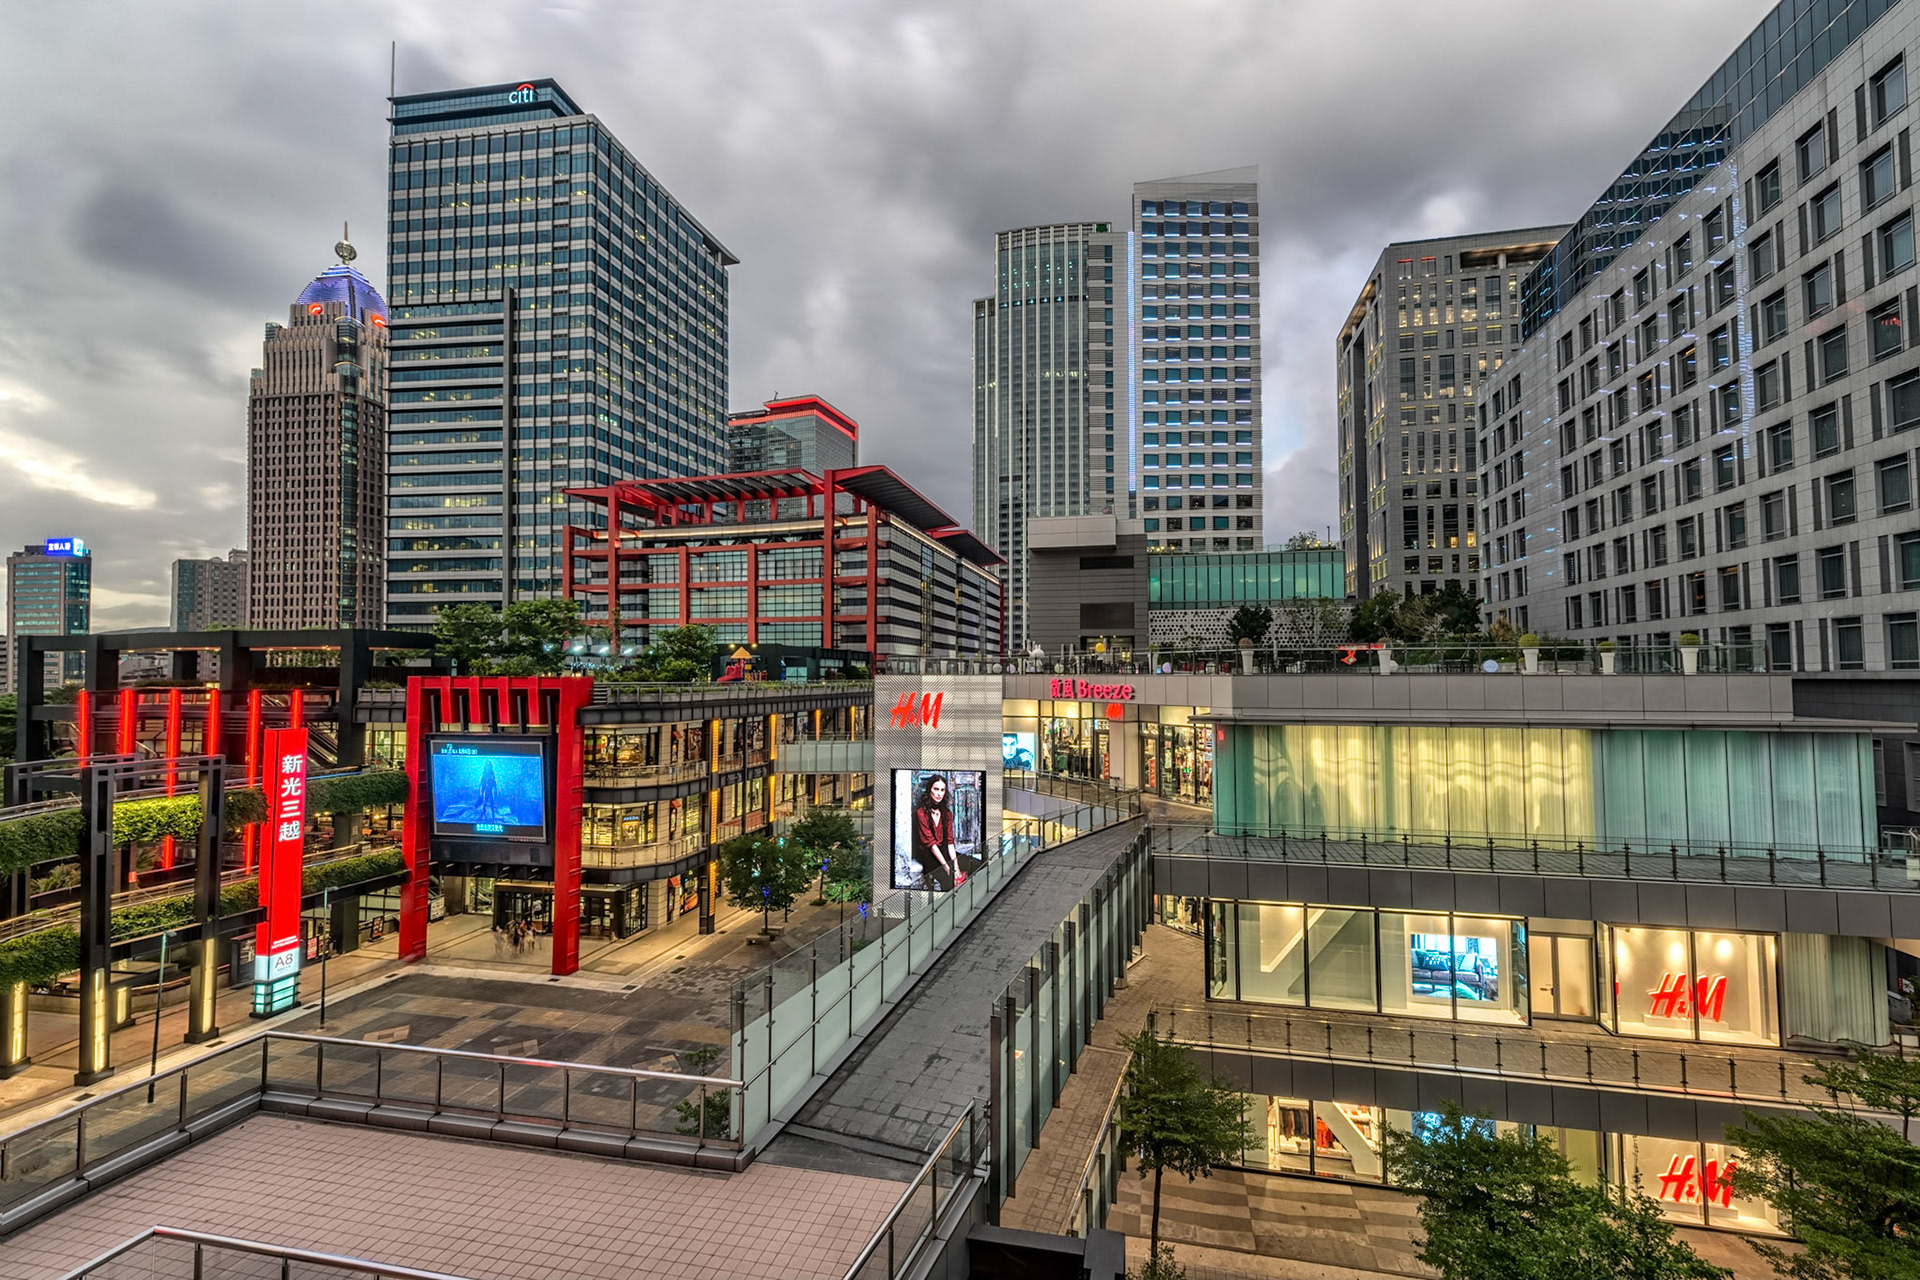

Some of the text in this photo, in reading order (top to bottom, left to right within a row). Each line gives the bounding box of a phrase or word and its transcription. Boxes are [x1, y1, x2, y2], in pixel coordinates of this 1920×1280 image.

[509, 87, 534, 104] citi
[1078, 680, 1132, 700] Breeze
[890, 691, 943, 730] H&M
[279, 755, 303, 842] 新光三越
[275, 953, 294, 969] A8
[1648, 972, 1728, 1022] H&M
[1657, 1154, 1737, 1208] H&M
